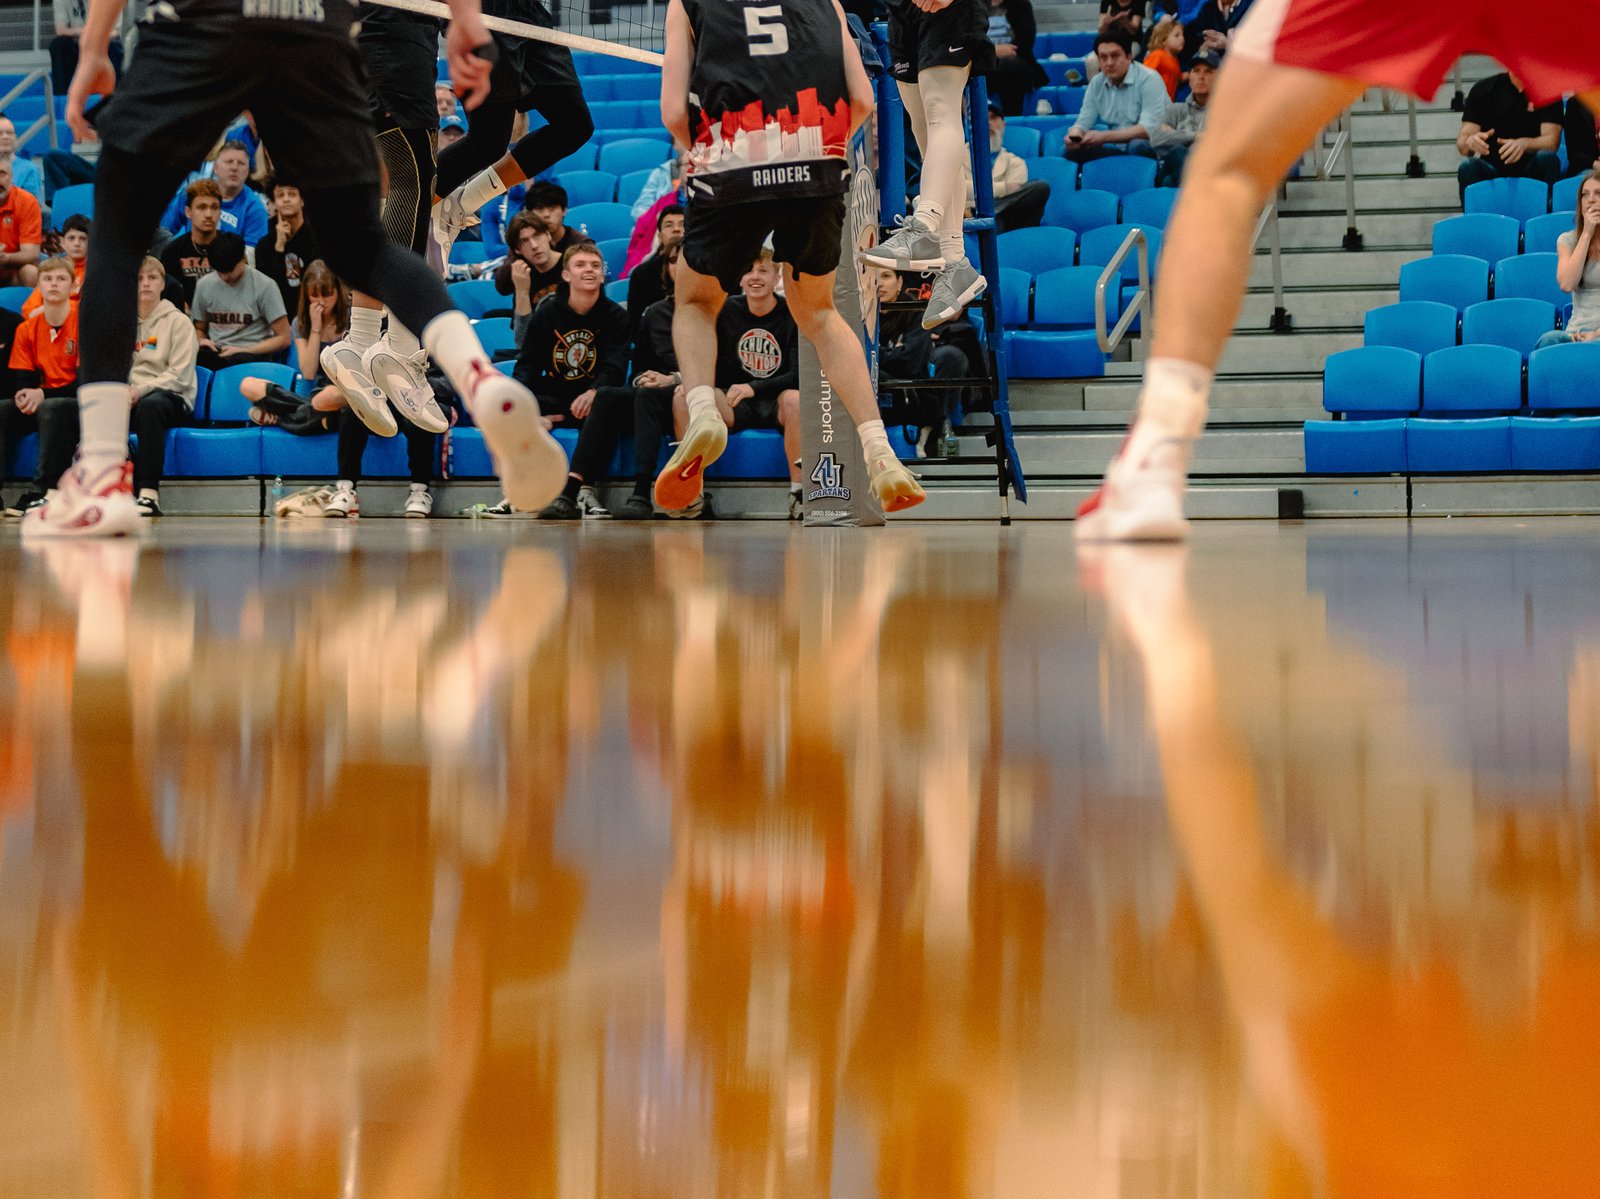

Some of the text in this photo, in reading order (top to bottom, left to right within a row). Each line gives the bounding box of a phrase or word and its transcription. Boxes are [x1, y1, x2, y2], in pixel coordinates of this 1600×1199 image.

[743, 4, 789, 57] 5
[752, 165, 811, 187] RAIDERS
[743, 337, 776, 356] CHUCK
[819, 381, 834, 443] imports
[808, 487, 849, 500] SPARTANS
